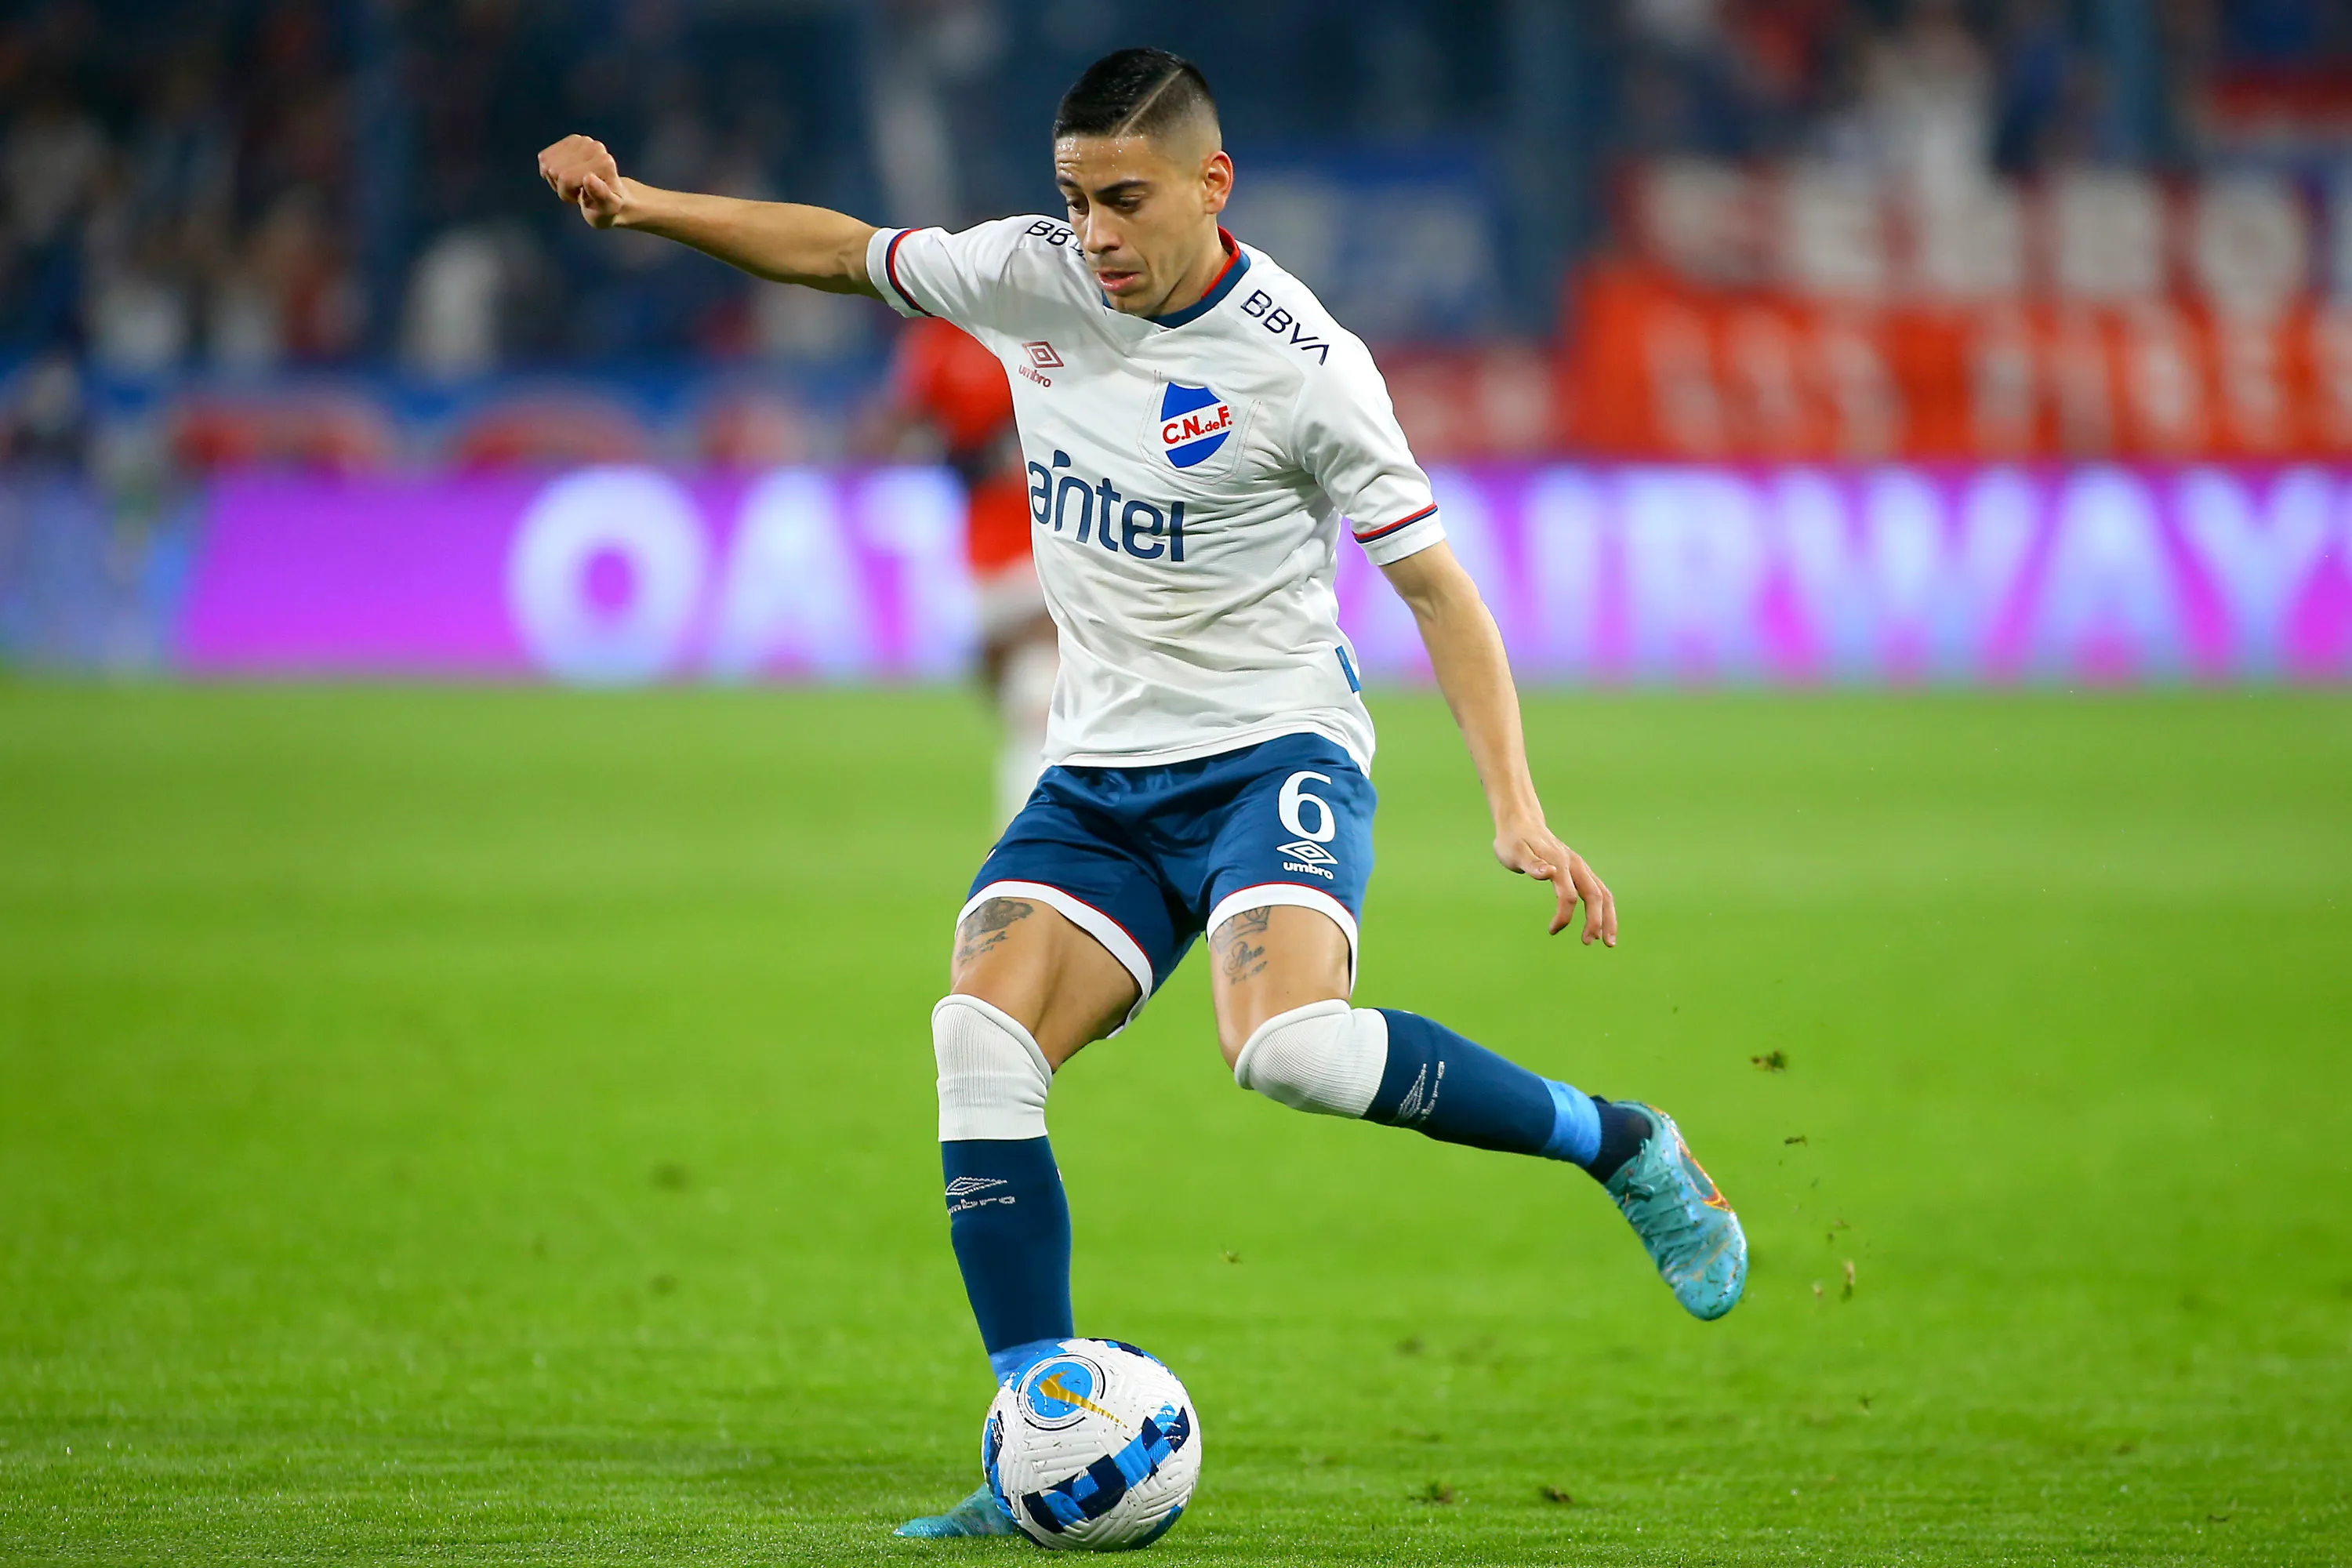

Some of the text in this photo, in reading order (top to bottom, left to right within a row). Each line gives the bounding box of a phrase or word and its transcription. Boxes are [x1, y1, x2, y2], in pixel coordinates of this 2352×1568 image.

[1240, 289, 1330, 365] BBVA
[1018, 364, 1051, 387] umbro
[1029, 449, 1185, 562] antel
[1279, 771, 1335, 843] 6
[1283, 862, 1334, 880] umbro
